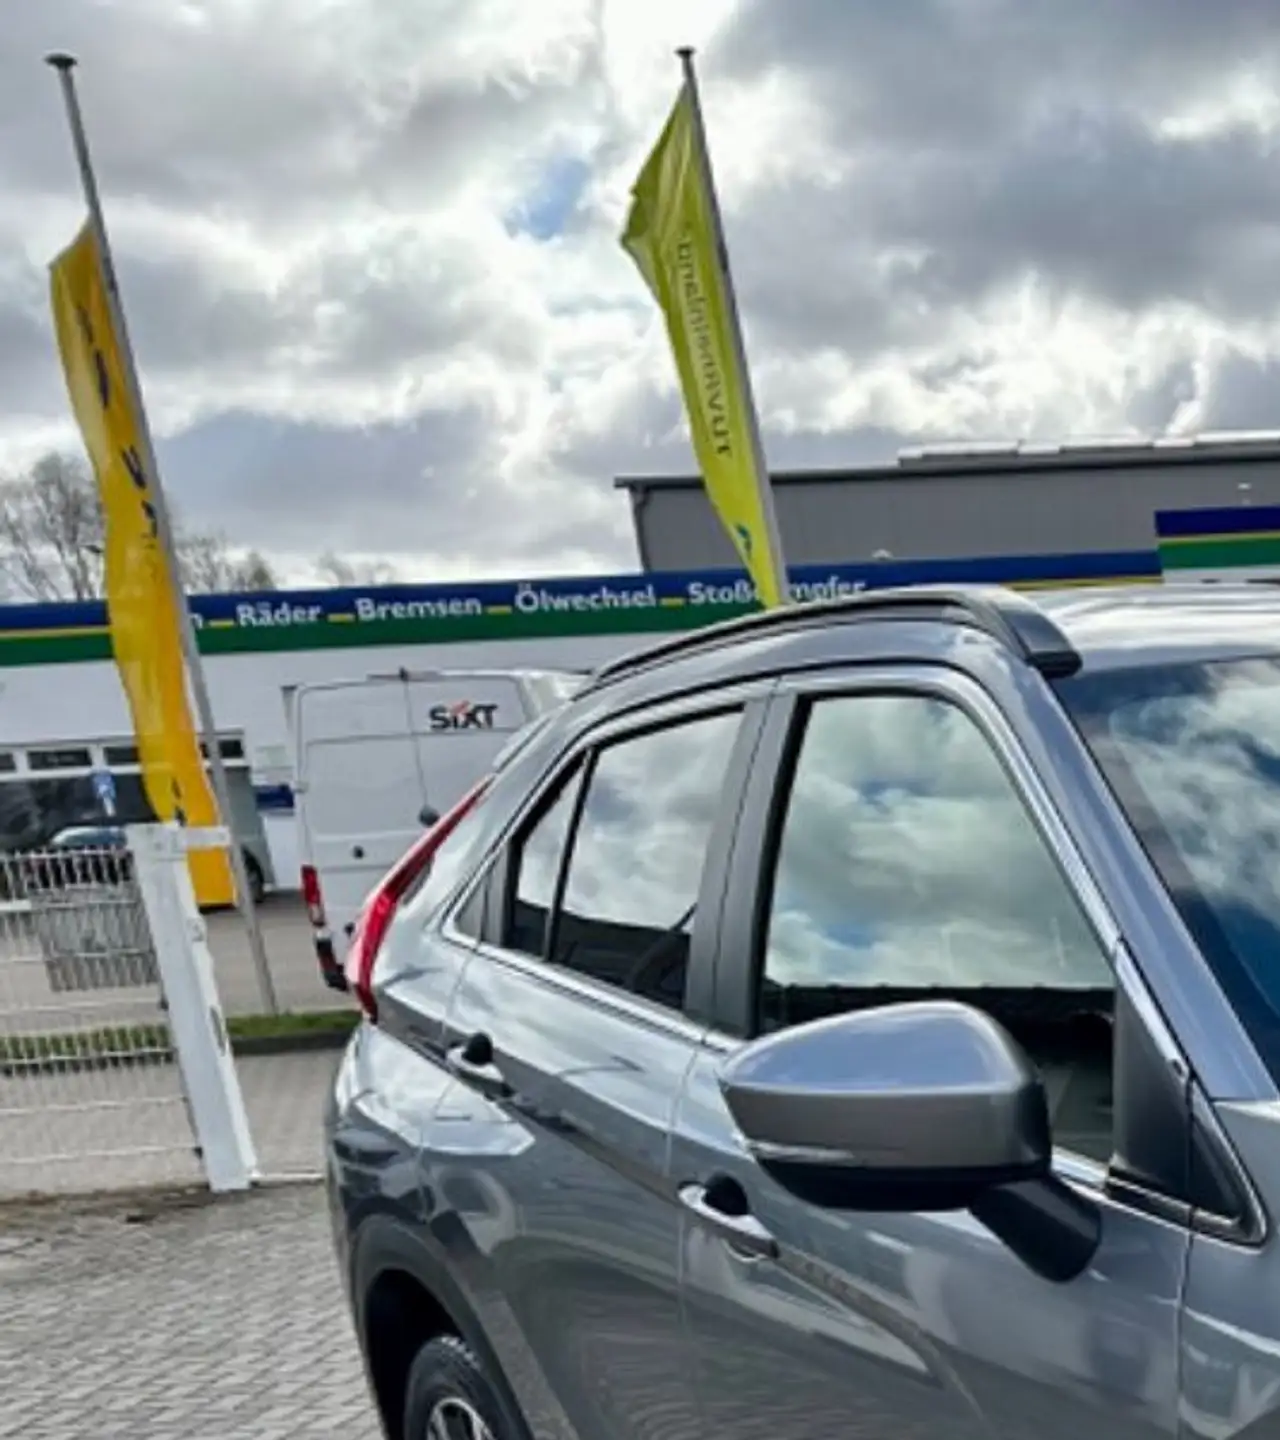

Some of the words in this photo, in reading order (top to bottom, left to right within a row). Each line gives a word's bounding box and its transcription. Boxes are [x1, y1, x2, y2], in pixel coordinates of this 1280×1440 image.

[236, 601, 321, 627] Räder
[354, 597, 482, 621] Bremsen
[514, 583, 656, 613] Ölwechsel
[688, 575, 866, 605] Stoßmpfer
